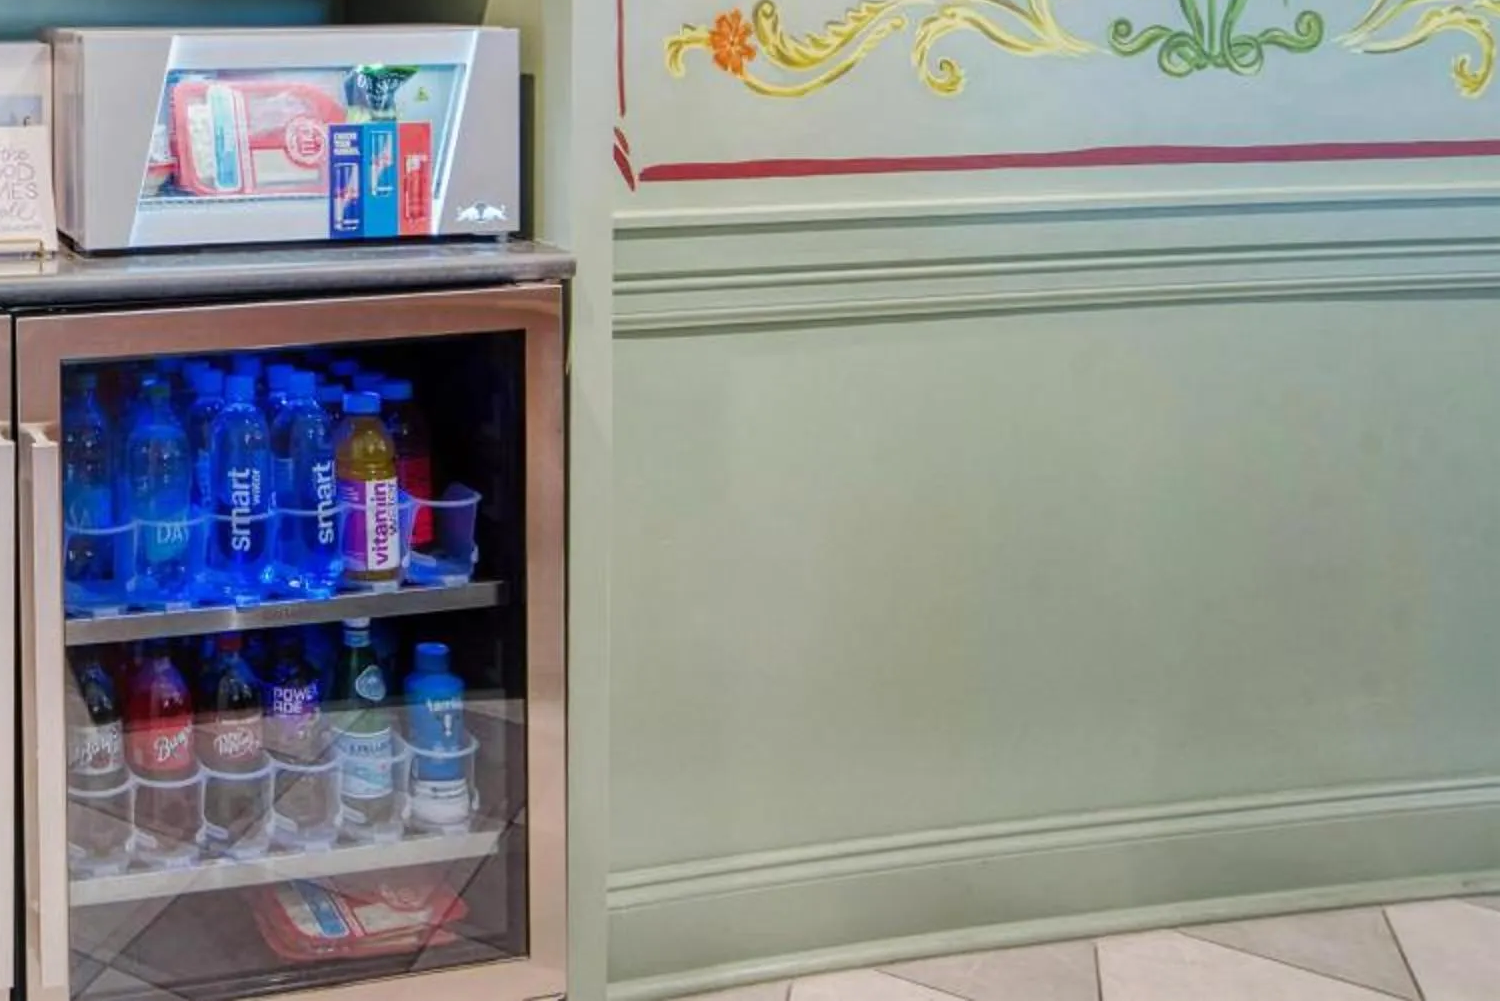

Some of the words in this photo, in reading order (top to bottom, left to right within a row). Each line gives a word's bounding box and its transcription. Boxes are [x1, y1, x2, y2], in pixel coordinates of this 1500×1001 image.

[227, 467, 251, 552] smart
[312, 460, 335, 545] smart
[372, 482, 390, 566] vitamin
